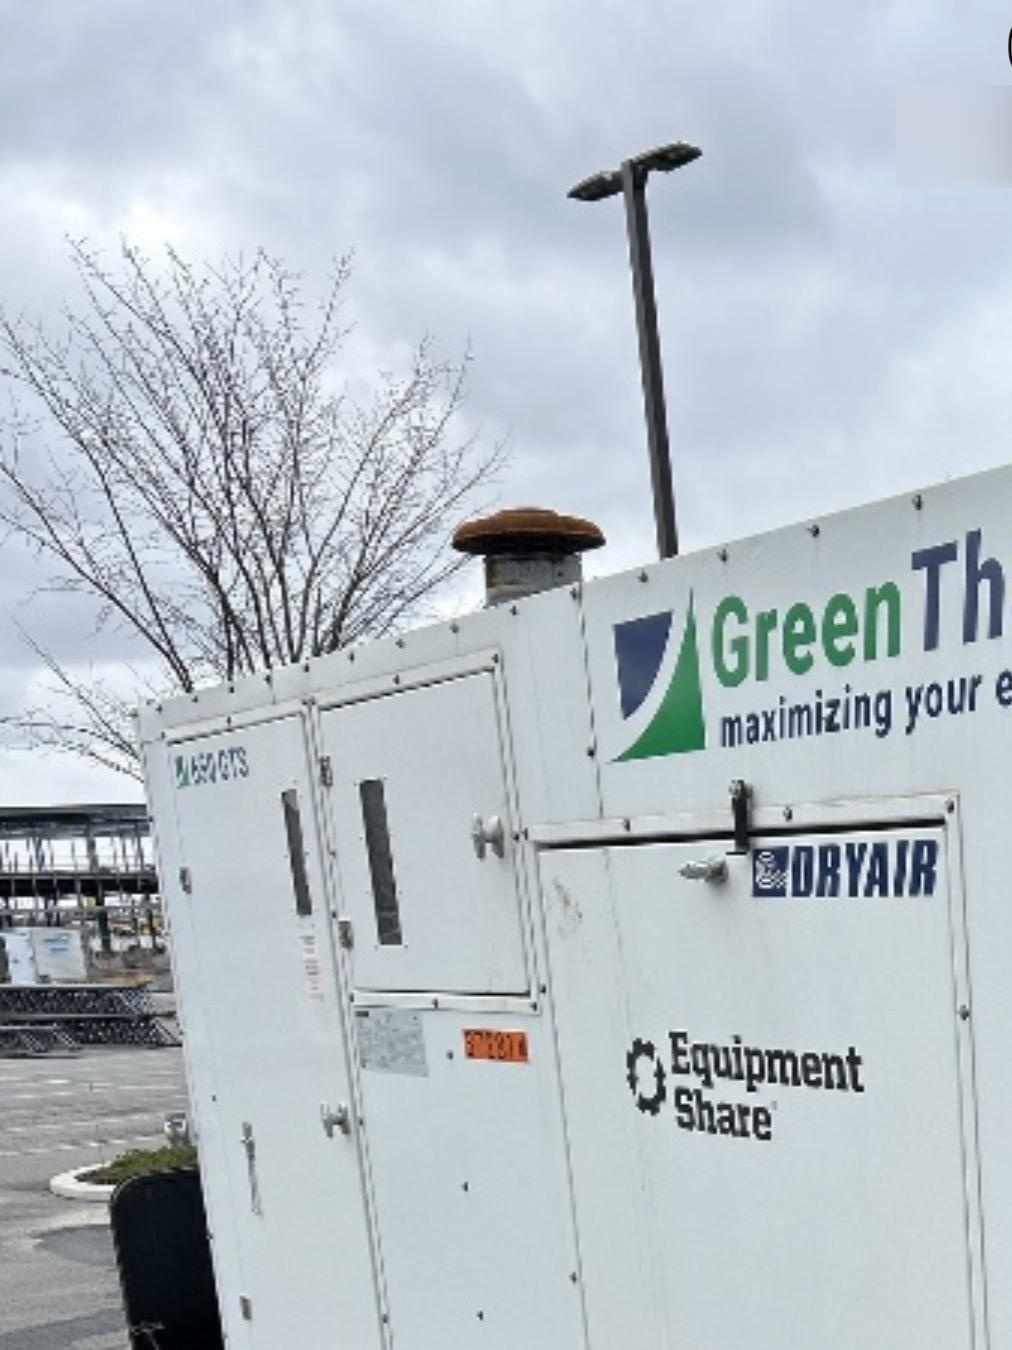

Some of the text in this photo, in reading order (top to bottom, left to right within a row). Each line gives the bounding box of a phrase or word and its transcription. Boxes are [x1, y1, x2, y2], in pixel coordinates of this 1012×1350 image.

[720, 682, 892, 748] maximizing
[905, 674, 982, 736] your
[791, 840, 938, 897] DRYAIR
[668, 1031, 864, 1092] Equipment
[674, 1086, 771, 1140] Share
